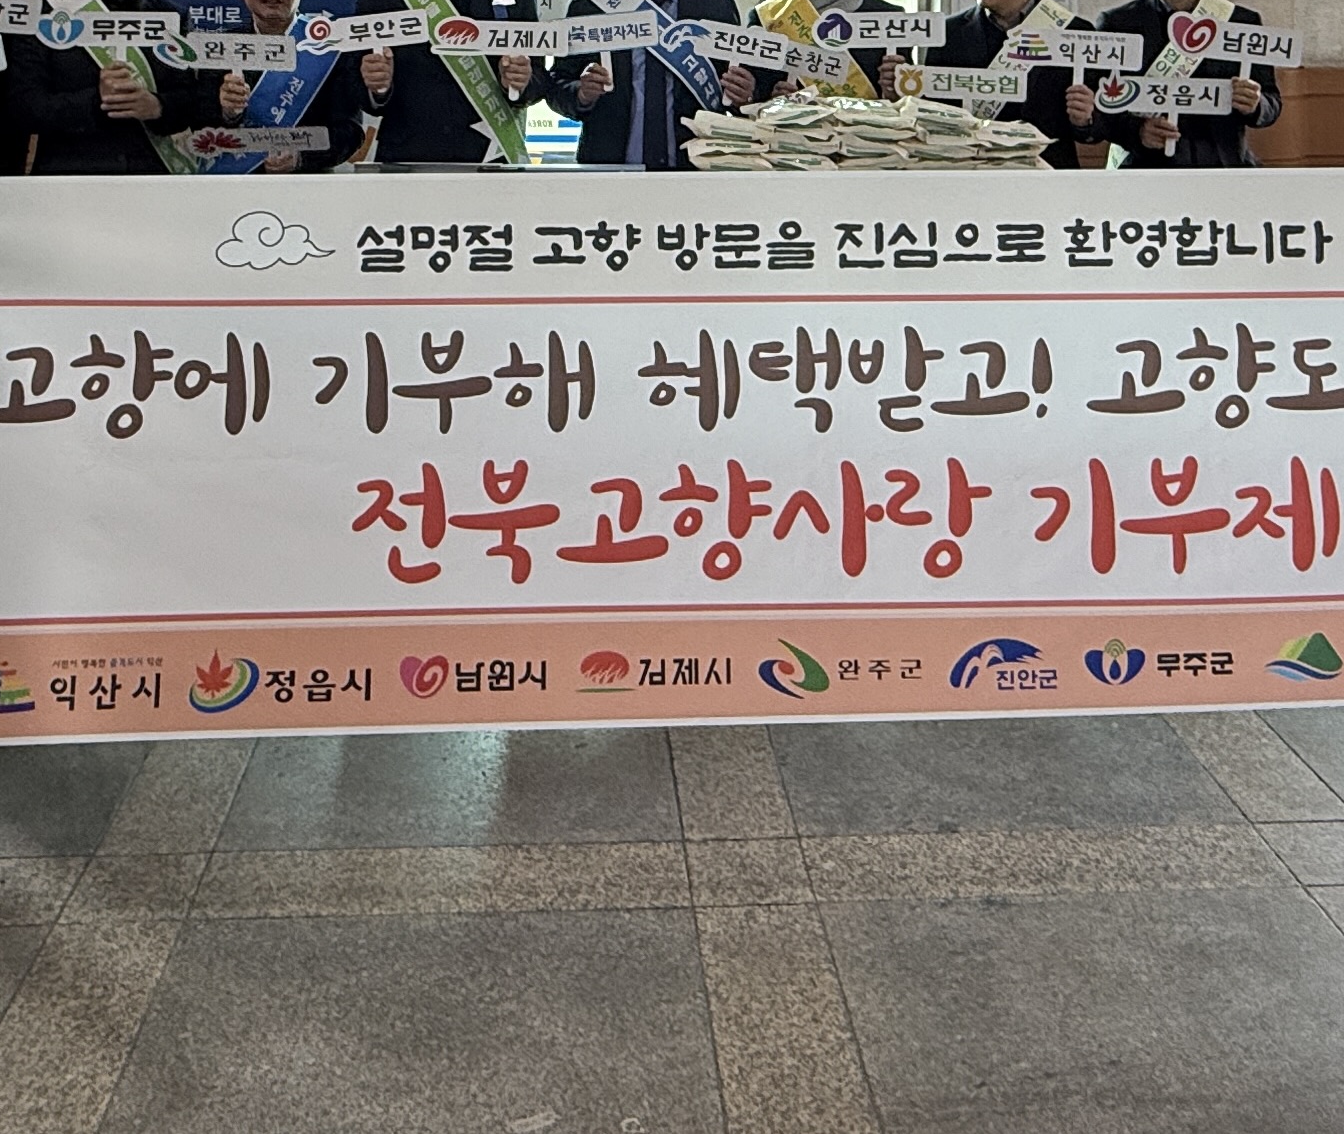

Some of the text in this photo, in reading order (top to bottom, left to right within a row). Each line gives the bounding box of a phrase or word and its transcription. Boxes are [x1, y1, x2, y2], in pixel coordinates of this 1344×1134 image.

[188, 5, 243, 26] 부대로
[92, 19, 167, 42] 무주군
[349, 17, 422, 42] 부안군
[488, 29, 557, 49] 김제시
[568, 21, 653, 44] 북특별자치도
[859, 18, 932, 39] 군산시
[205, 41, 287, 63] 완주군
[714, 30, 783, 60] 진안군
[1059, 42, 1126, 66] 익산시
[1223, 30, 1294, 58] 남원시
[785, 47, 843, 77] 순창군
[931, 72, 1019, 96] 전북농협
[1147, 85, 1221, 108] 정읍시
[355, 216, 1333, 273] 설명절 고향 방문을 진심으로 환영합니다
[312, 329, 597, 435] 기부해
[637, 325, 1055, 433] 혜택받고!
[351, 455, 1342, 585] 전북고향사랑 기부제
[49, 671, 163, 711] 익산시
[265, 667, 373, 704] 정읍시
[454, 659, 548, 692] 남원시
[637, 657, 733, 687] 김제시
[838, 658, 923, 683] 완주군
[995, 668, 1059, 692] 진안군
[1156, 651, 1235, 677] 무주군
